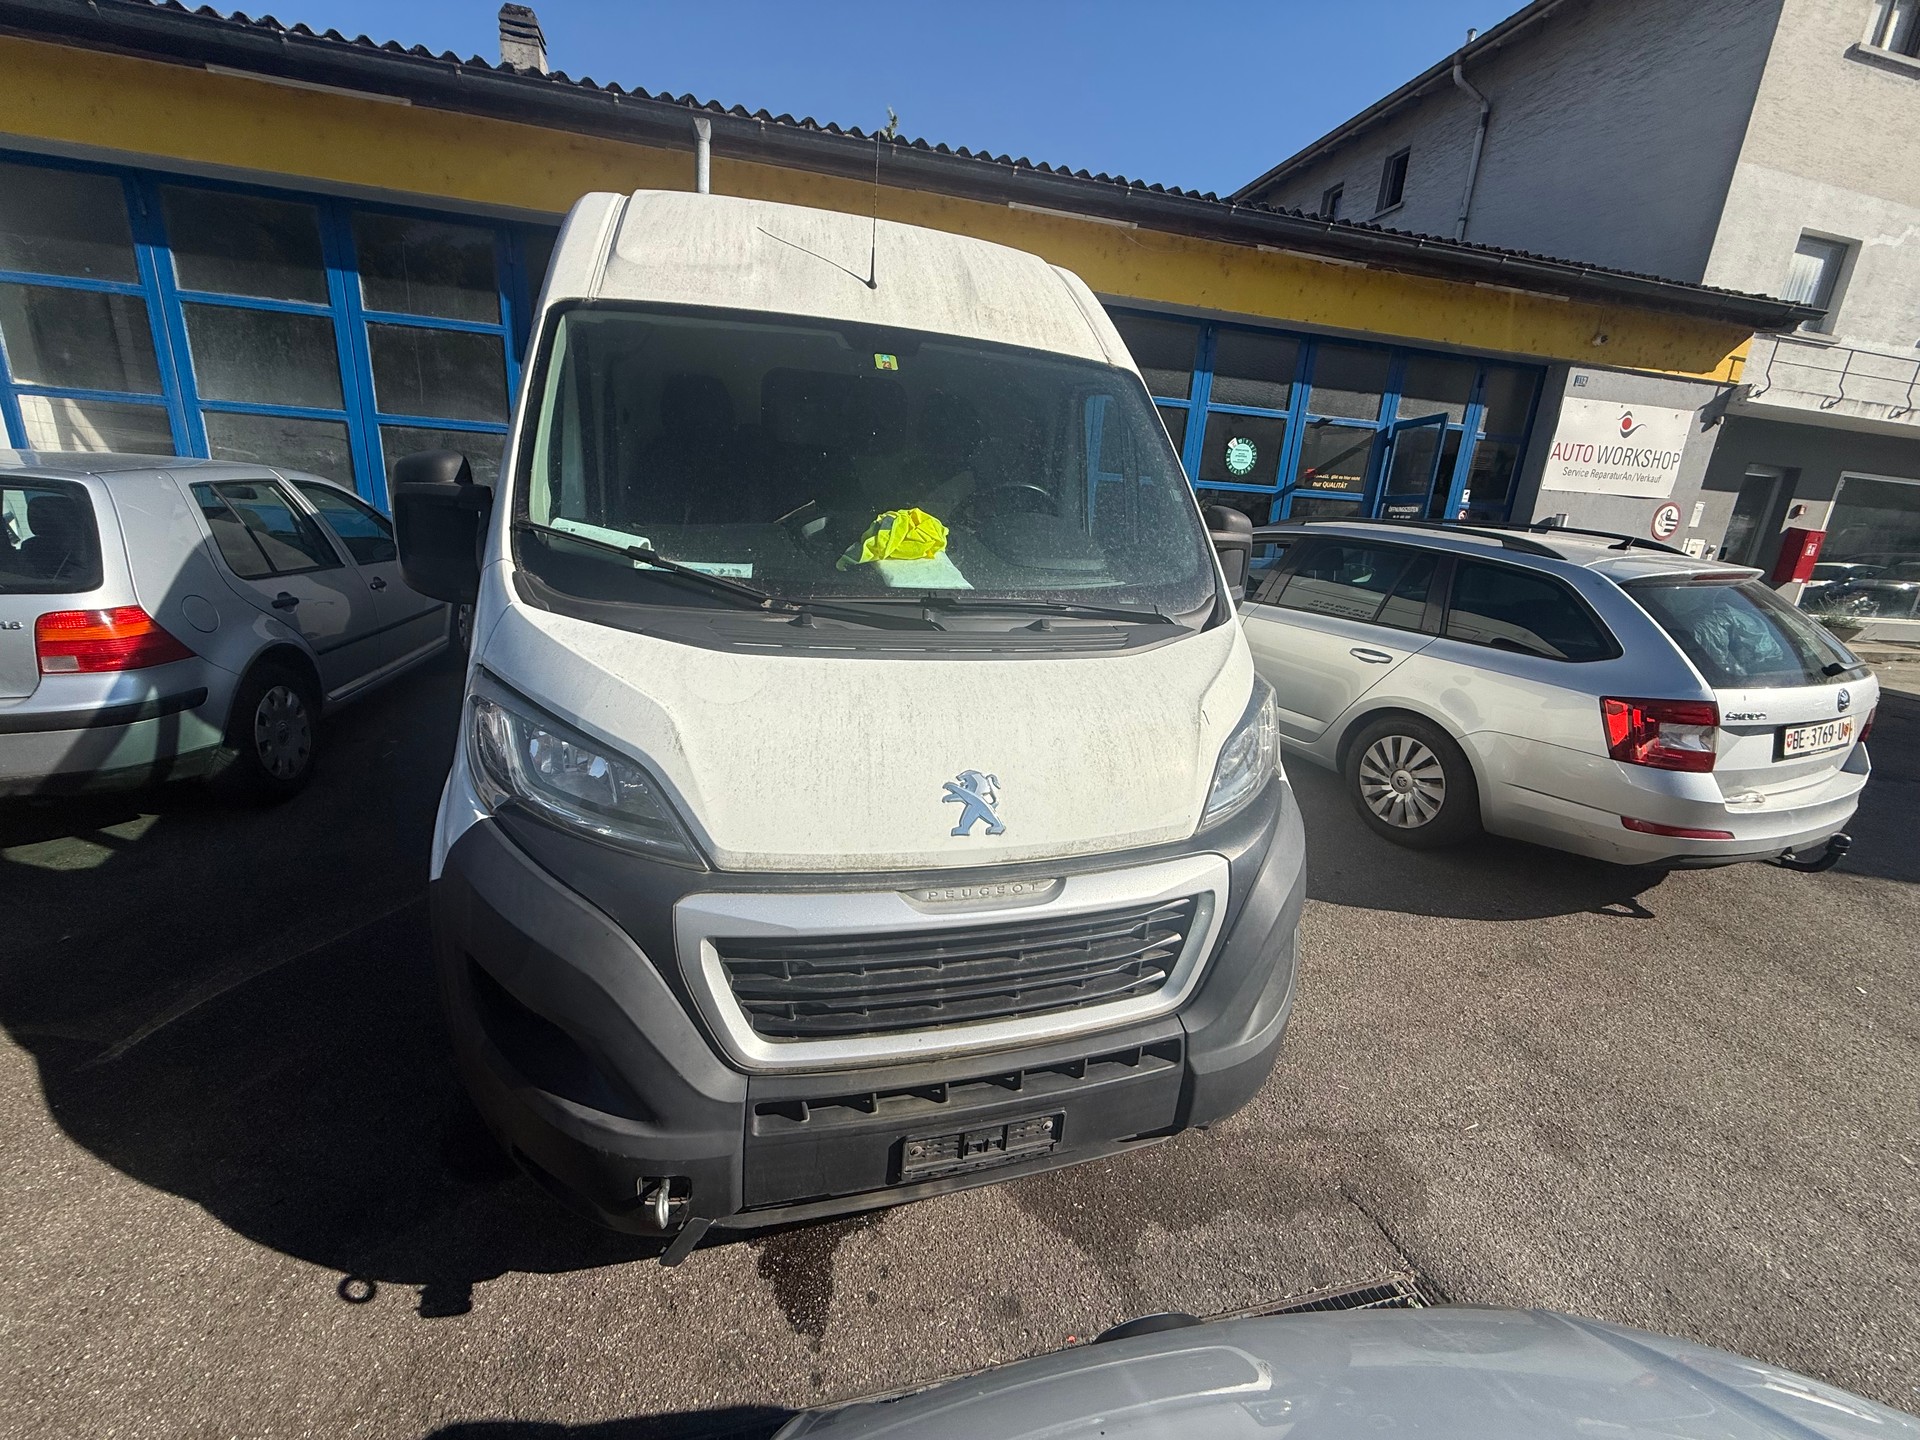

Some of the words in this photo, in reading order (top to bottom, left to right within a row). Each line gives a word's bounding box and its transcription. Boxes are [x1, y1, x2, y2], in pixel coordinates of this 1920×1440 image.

[1550, 442, 1594, 463] AUTO
[1597, 445, 1680, 470] WORKSHOP
[1562, 466, 1589, 478] Service
[927, 882, 1039, 900] PEUGEOT
